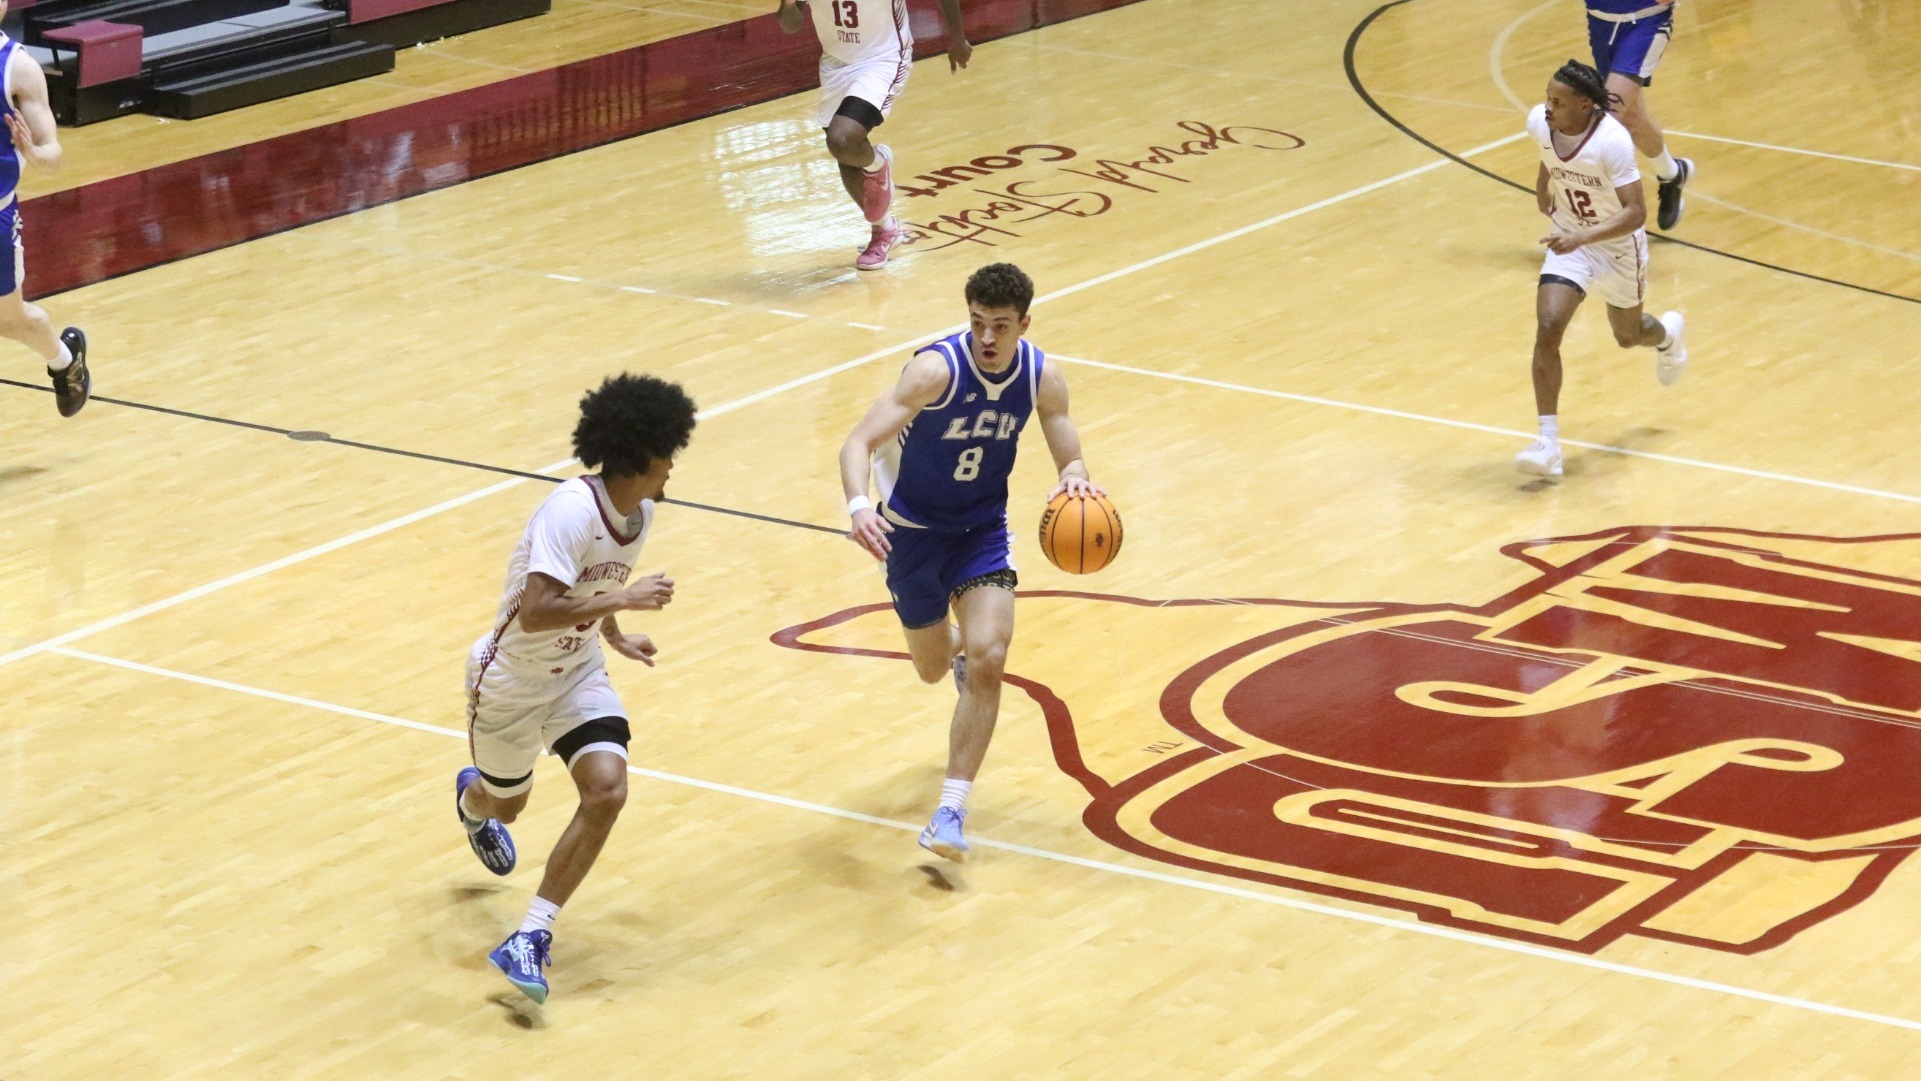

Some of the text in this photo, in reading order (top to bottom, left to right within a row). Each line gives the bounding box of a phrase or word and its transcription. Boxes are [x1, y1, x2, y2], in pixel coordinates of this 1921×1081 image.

[832, 0, 859, 28] 13
[837, 30, 860, 43] STATE
[893, 120, 1306, 252] Gerald Stockto
[895, 144, 1077, 198] Court
[1564, 188, 1598, 219] 12
[941, 409, 1019, 441] LCU
[953, 446, 984, 482] 8
[1141, 740, 1184, 754] TM
